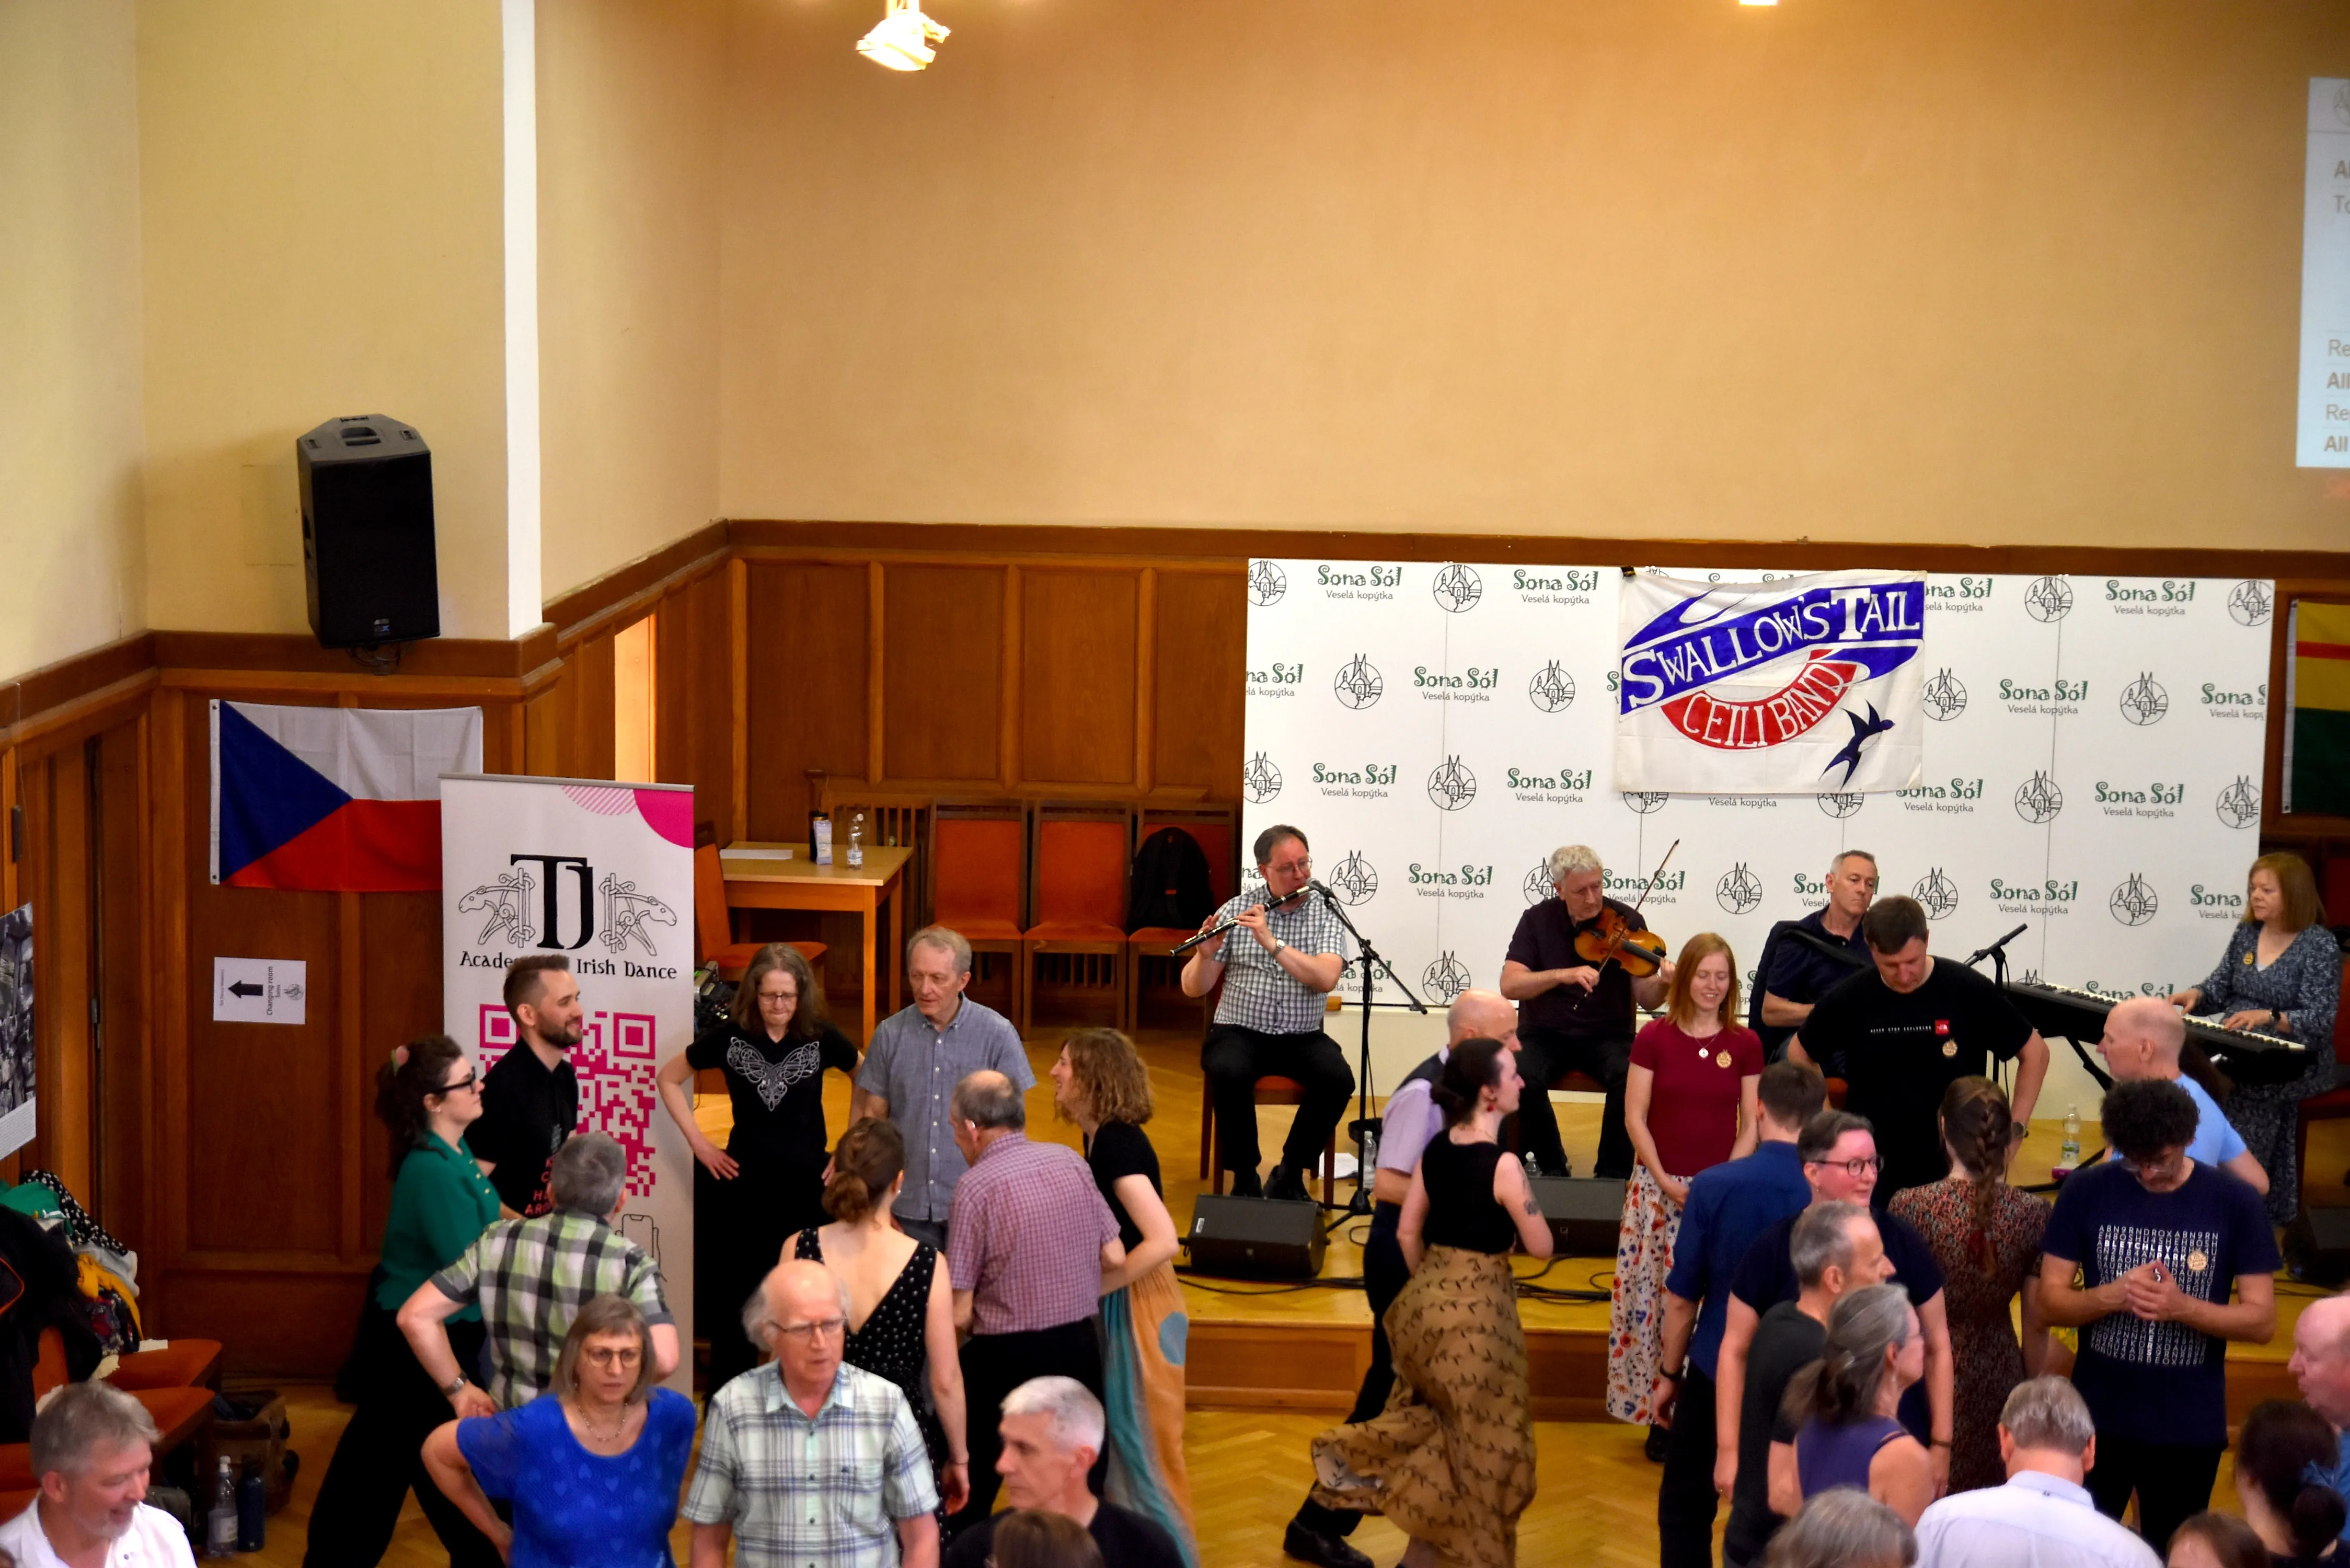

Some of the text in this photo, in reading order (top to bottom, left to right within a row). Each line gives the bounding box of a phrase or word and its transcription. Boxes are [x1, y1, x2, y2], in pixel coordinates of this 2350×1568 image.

[2326, 403, 2350, 424] Re
[2324, 435, 2347, 452] All
[1318, 565, 1402, 587] Sona Sól
[1513, 569, 1598, 592] Sona Sól
[1326, 590, 1393, 602] Veselá kopýtka
[1926, 578, 1992, 598] na Sól
[2105, 580, 2195, 602] Sona Sól
[1522, 594, 1589, 606] Veselá kopýtka
[1946, 602, 1983, 613] kopýtka
[2114, 605, 2185, 617] Veselá kopýtka
[1272, 663, 1303, 684] Sól
[1414, 666, 1498, 689] Sona Sól
[1259, 687, 1295, 698] kopýtka
[1422, 691, 1490, 703] Veselá kopýtka
[1999, 679, 2088, 701] Sona Sól
[2202, 683, 2253, 705] Sona
[1683, 663, 1845, 748] CEILI BAND
[2007, 704, 2078, 716] Veselá kopýtka
[1313, 763, 1397, 785] Sona Sól
[1507, 768, 1592, 790] Sona Sól
[1321, 788, 1388, 799] Veselá kopýtka
[1515, 793, 1583, 804] Veselá kopýtka
[1951, 778, 1983, 800] Sól
[2095, 781, 2184, 804] Sona Sól
[1709, 797, 1777, 808] Veselá kopýtka
[1904, 802, 1973, 814] Veselá kopýtka
[2103, 807, 2174, 818] Veselá kopýtka
[1409, 863, 1493, 886] Sona Sól
[1653, 870, 1685, 890] Sól
[1416, 888, 1484, 900] Veselá kopýtka
[1639, 894, 1676, 905] kopýtka
[1990, 879, 2078, 902] Sona Sól
[2191, 884, 2241, 906] Sona
[1999, 904, 2068, 916] Veselá kopýtka
[459, 951, 677, 979] Acade Irish Dance
[1347, 983, 1383, 994] kopka
[2104, 1240, 2171, 1253] BLETCHLEY
